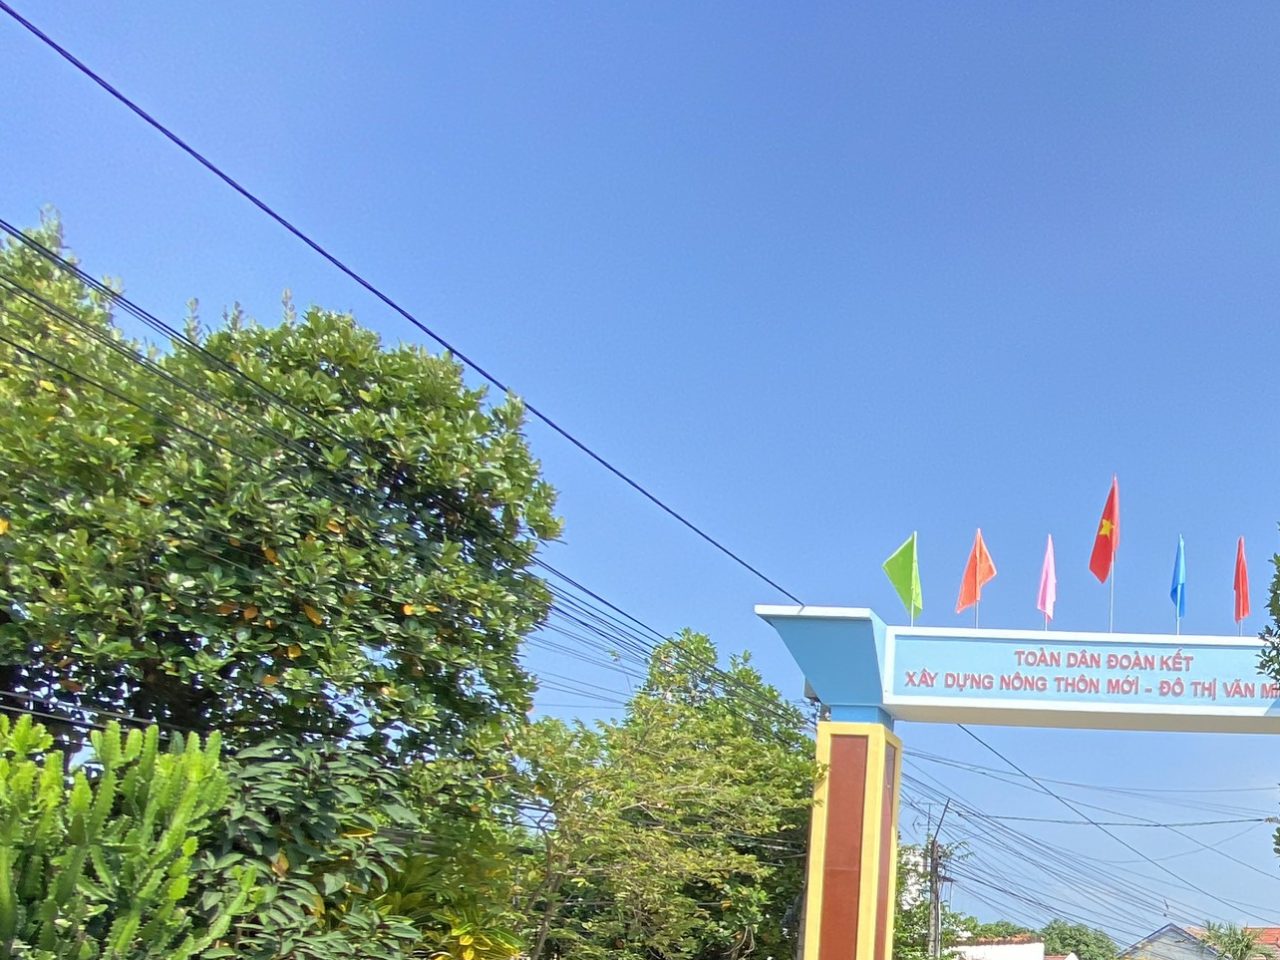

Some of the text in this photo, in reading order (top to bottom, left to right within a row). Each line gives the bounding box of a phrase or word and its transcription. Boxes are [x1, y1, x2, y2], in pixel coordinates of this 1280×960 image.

[1014, 647, 1194, 672] TOÀN DÂN ĐOÀN KẾT
[904, 668, 939, 688] XÂY
[944, 672, 994, 692] DỰNG
[1000, 672, 1048, 692] NÔNG
[1054, 674, 1099, 694] THÔN
[1106, 675, 1139, 695] MỚI
[1158, 677, 1184, 697] ĐÔ
[1190, 678, 1216, 701] THỊ
